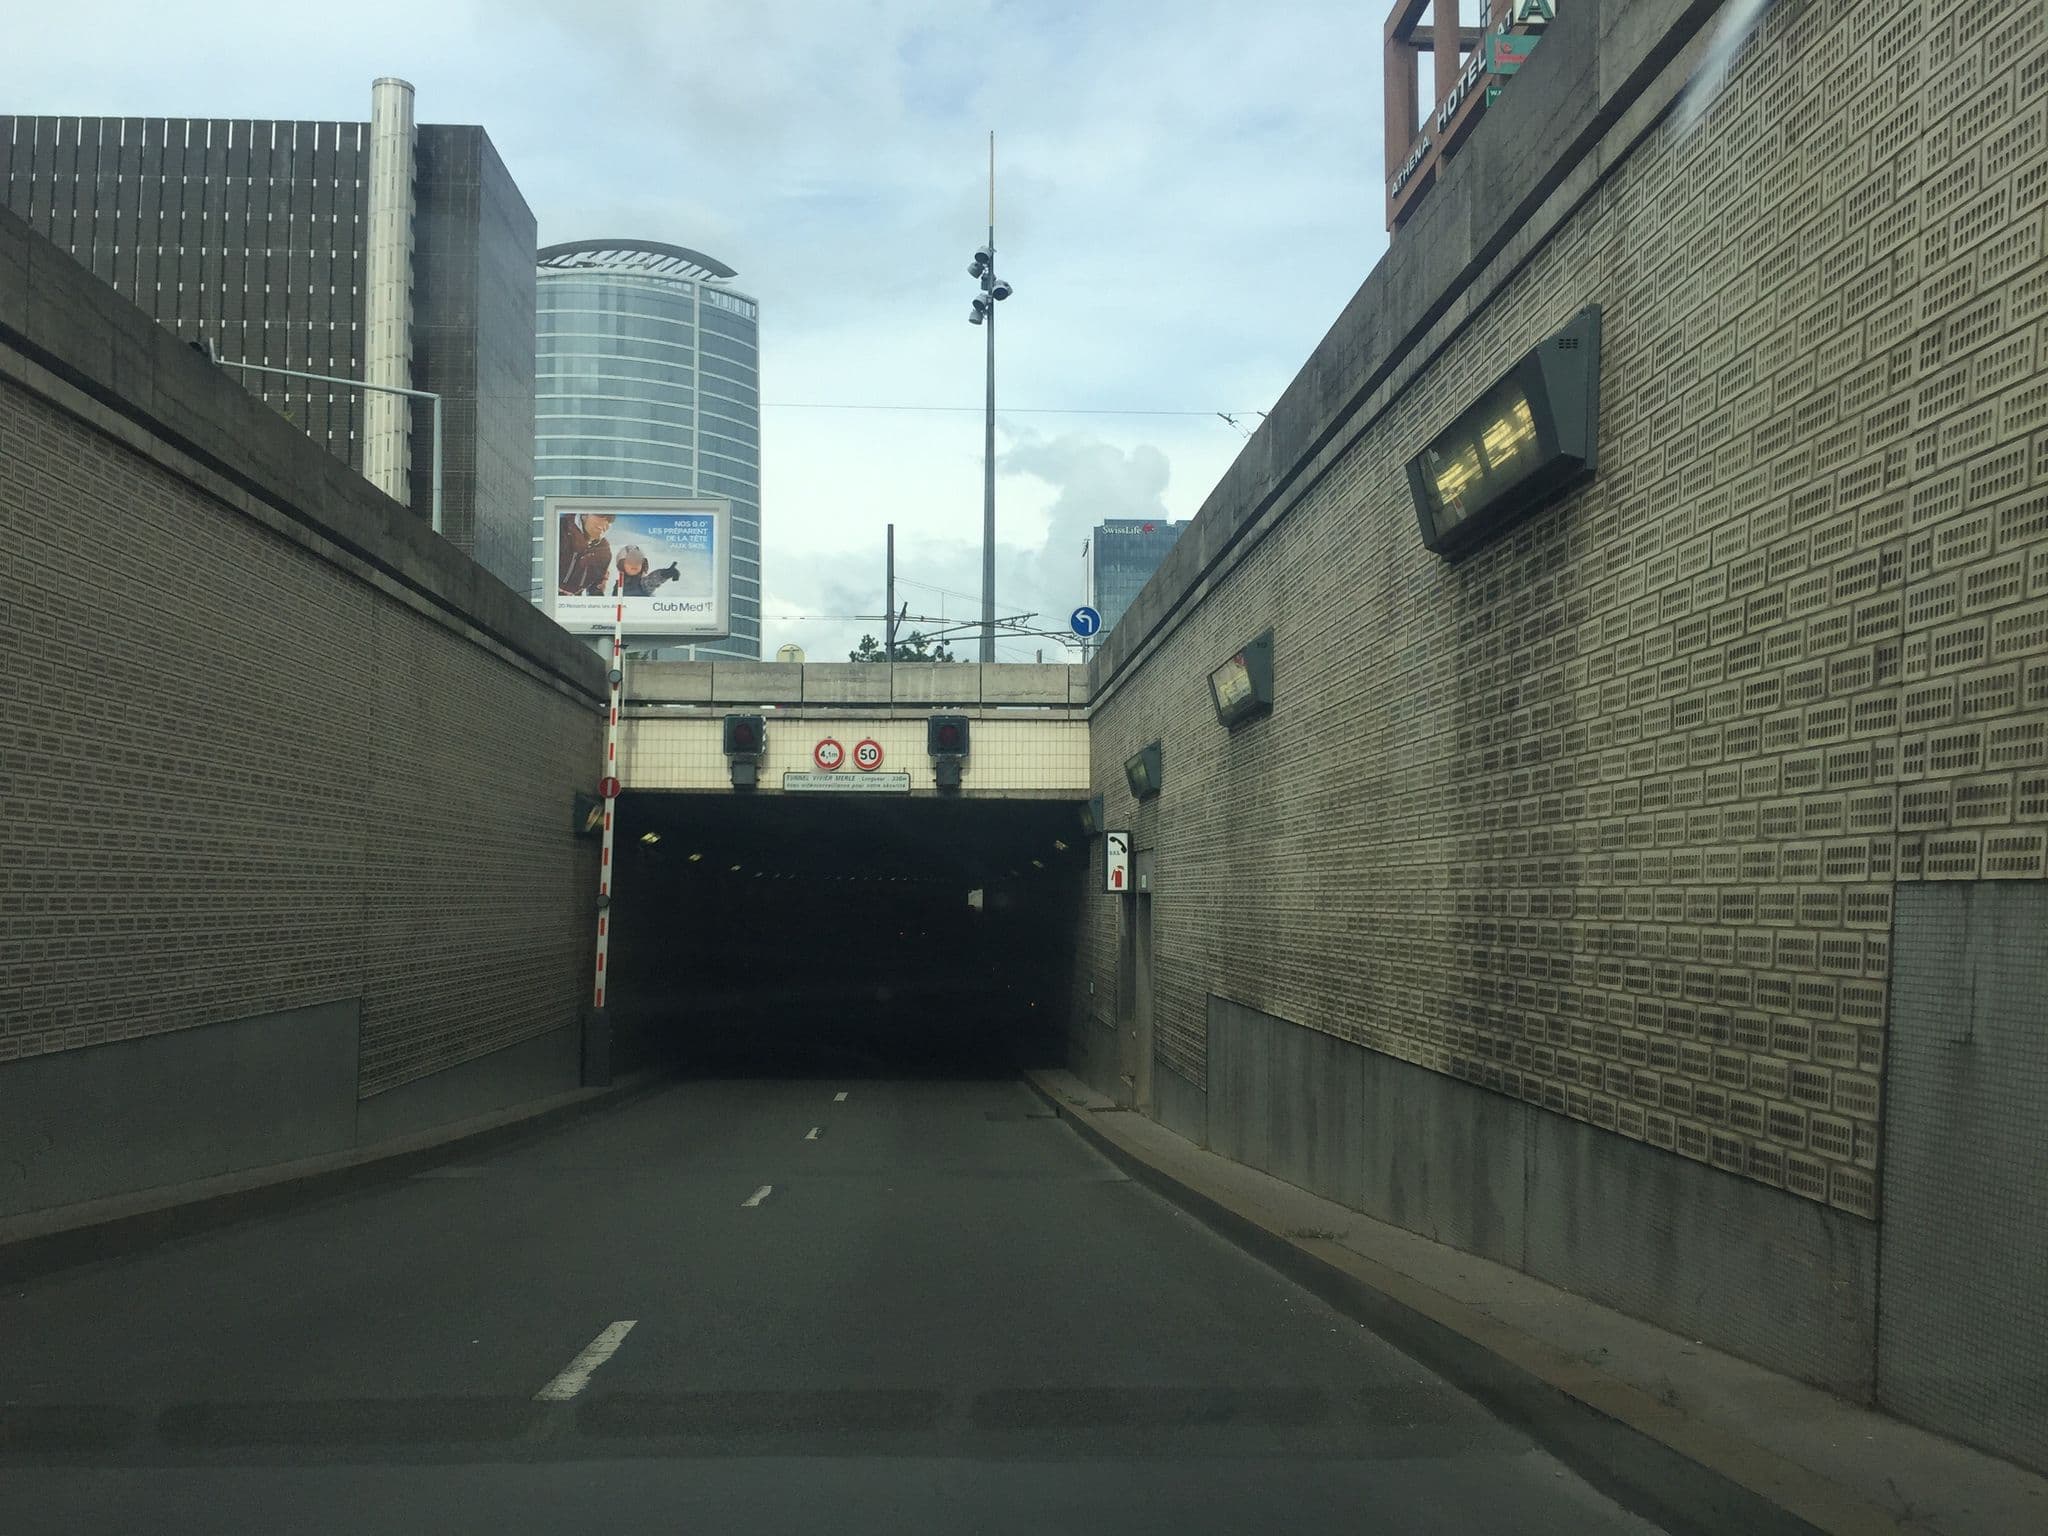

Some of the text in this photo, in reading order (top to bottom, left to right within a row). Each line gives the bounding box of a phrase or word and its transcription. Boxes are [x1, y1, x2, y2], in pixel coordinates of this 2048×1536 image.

[1391, 135, 1433, 198] ATHENA
[1436, 50, 1485, 133] HOTEL
[674, 520, 691, 528] NOS
[648, 527, 662, 535] LES
[652, 602, 703, 611] Club Med
[860, 748, 877, 760] 50
[835, 774, 857, 782] MERLE
